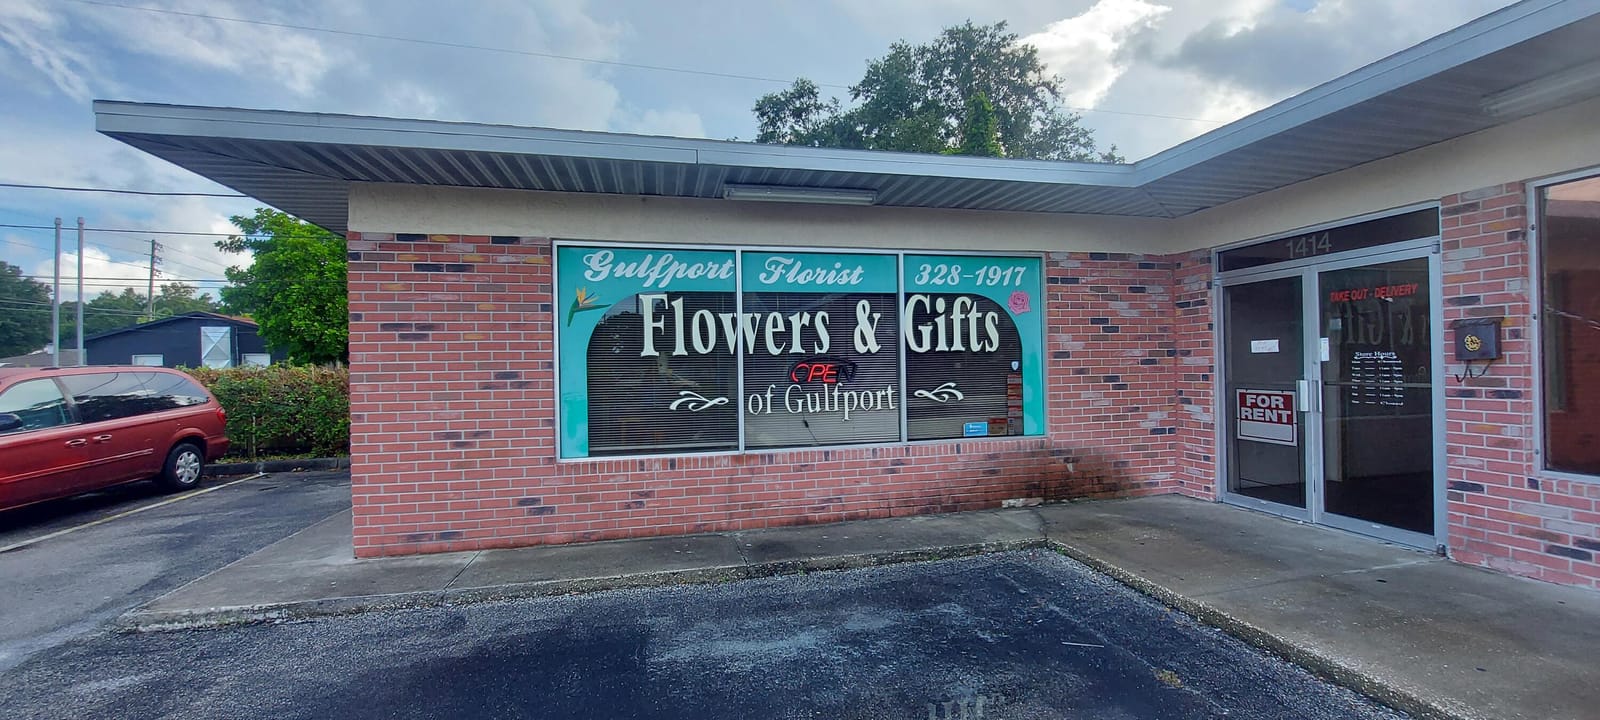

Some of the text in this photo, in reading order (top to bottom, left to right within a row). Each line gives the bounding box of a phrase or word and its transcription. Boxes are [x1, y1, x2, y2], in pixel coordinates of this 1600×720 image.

[1285, 232, 1332, 258] 1414
[583, 250, 1027, 288] Gulfport Florist 328-1917
[1330, 290, 1350, 303] TAKE
[1351, 288, 1369, 301] OUT
[1374, 283, 1419, 299] DELIVERY
[639, 294, 999, 357] Flowers & Gifts
[791, 362, 858, 384] OPEN
[748, 383, 898, 422] of Gulfport
[1246, 394, 1285, 409] FOR
[1240, 407, 1292, 423] RENT
